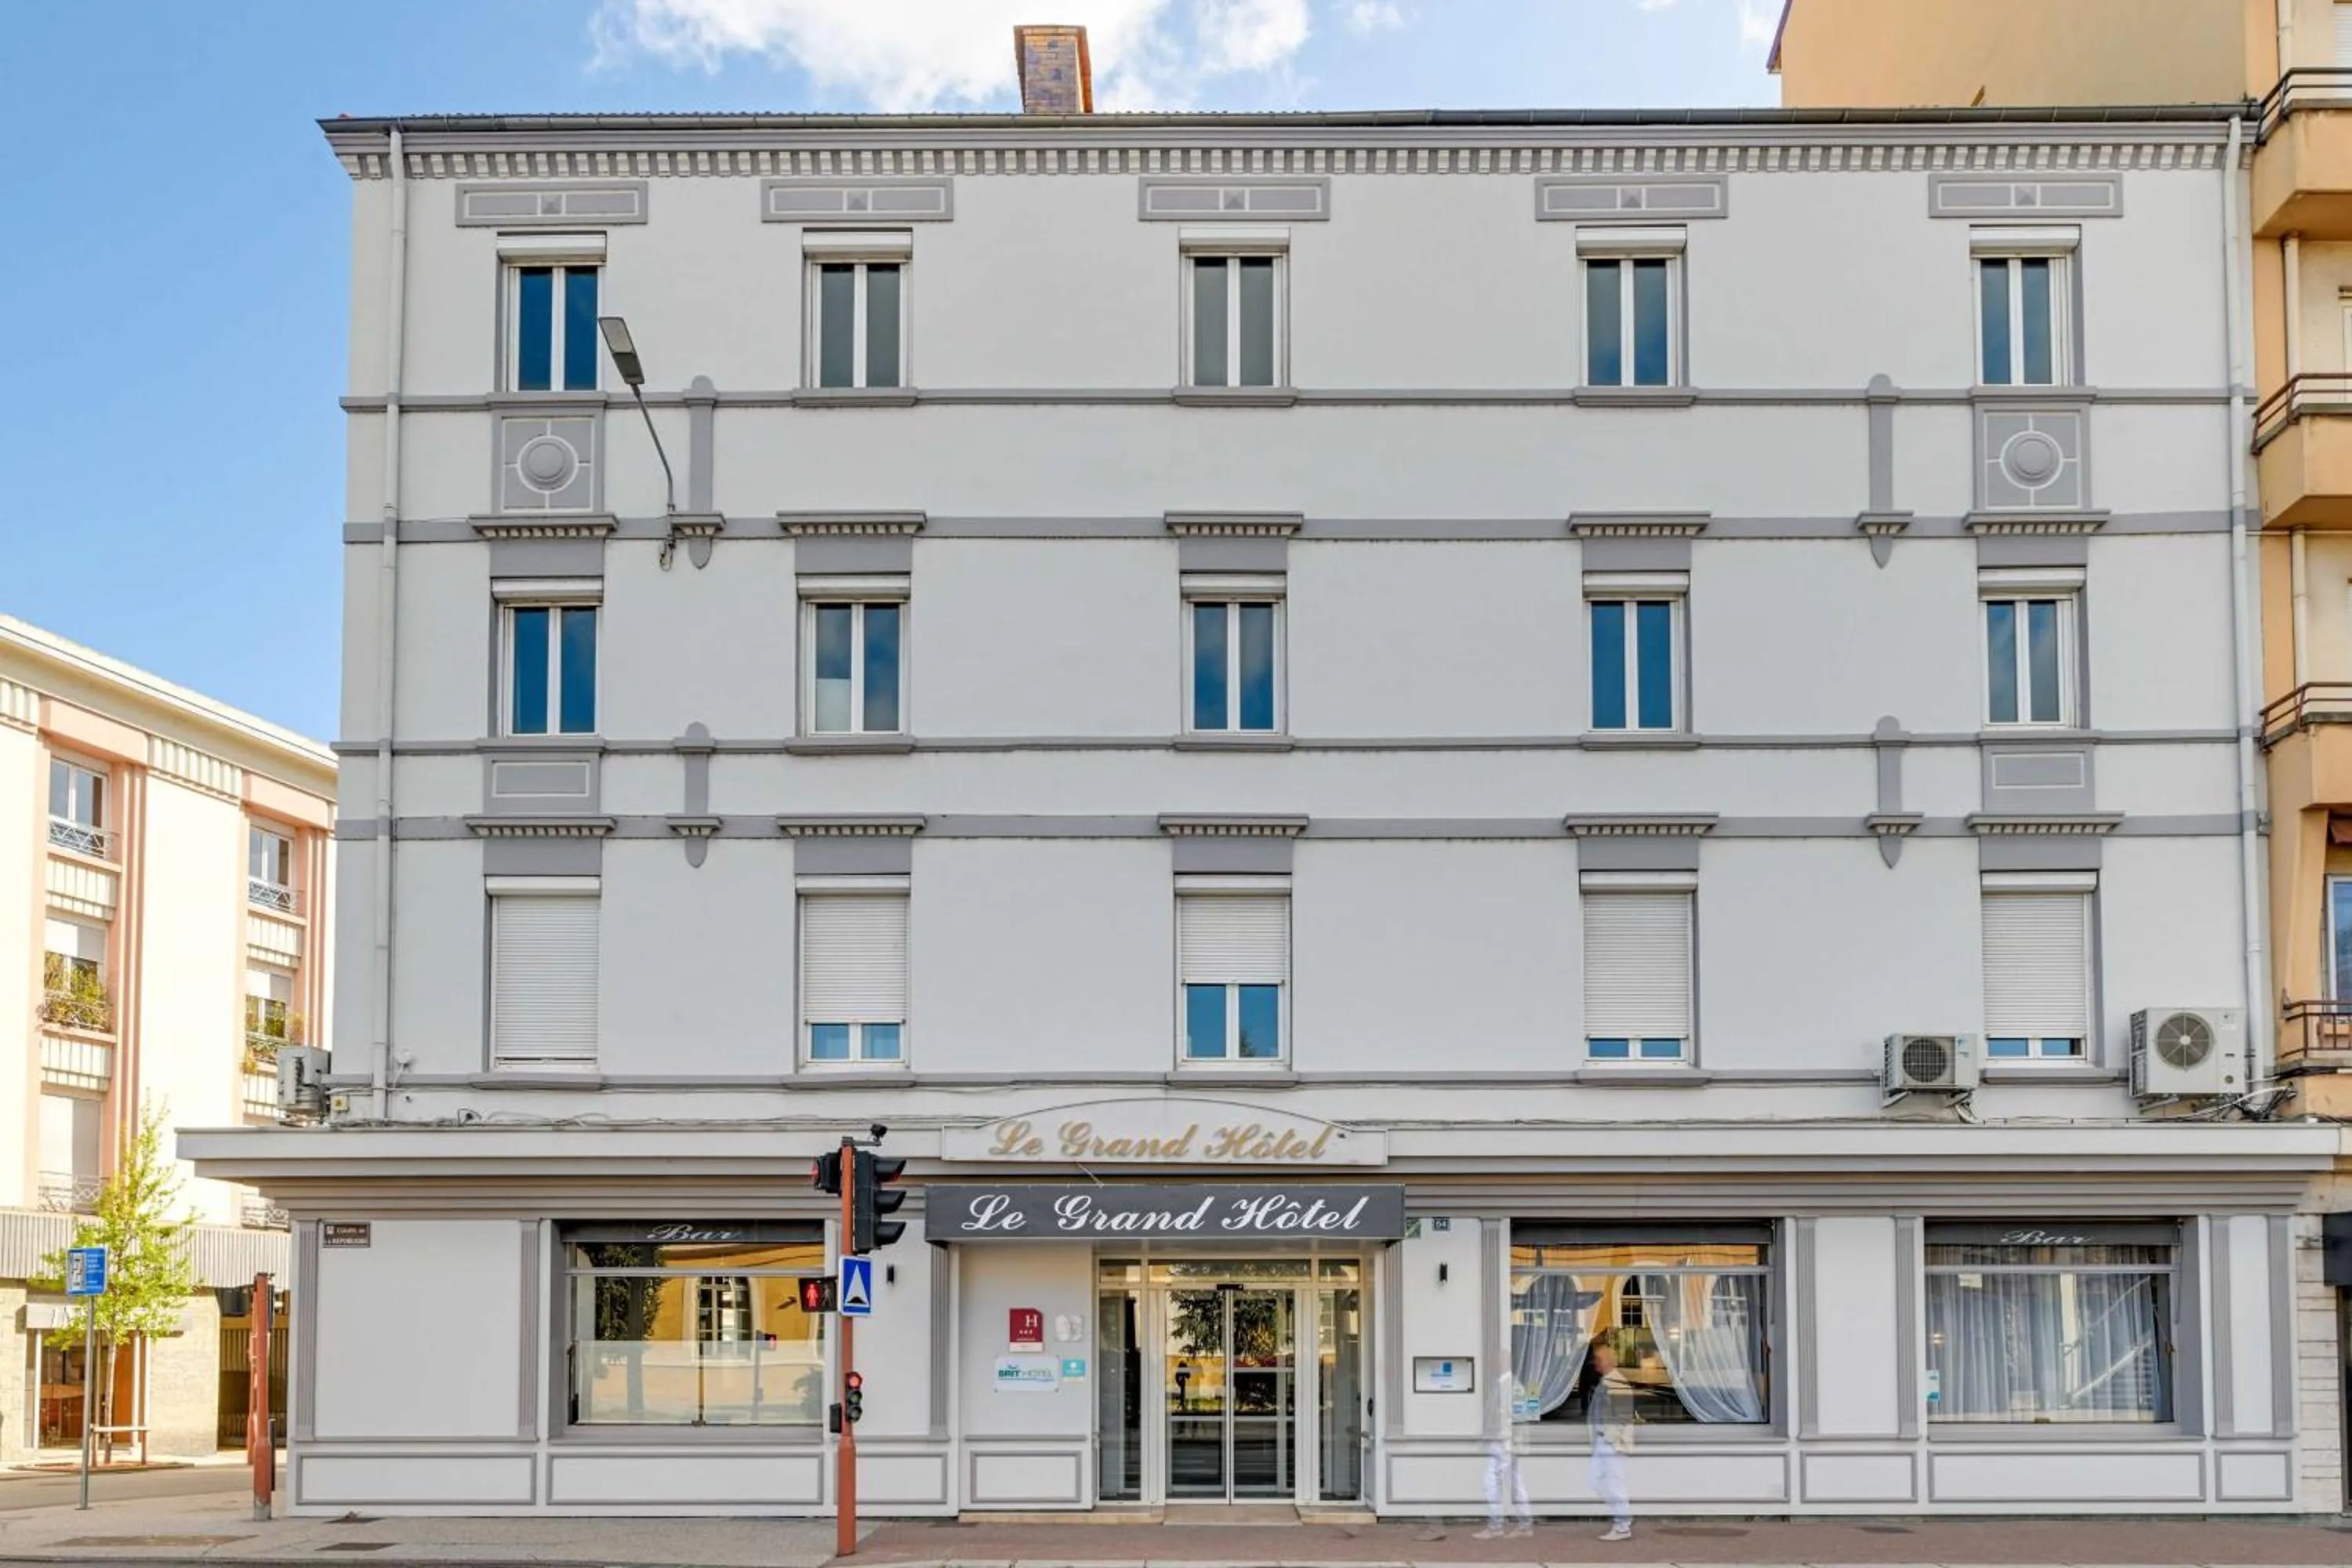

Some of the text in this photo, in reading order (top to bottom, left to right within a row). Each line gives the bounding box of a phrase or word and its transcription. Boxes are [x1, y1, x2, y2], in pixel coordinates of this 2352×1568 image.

[989, 1120, 1333, 1159] Le Grand Hôtel
[961, 1194, 1370, 1230] Le Grand Hôtel
[647, 1224, 742, 1239] Bar
[2000, 1230, 2095, 1243] Bar
[1025, 1315, 1038, 1327] H
